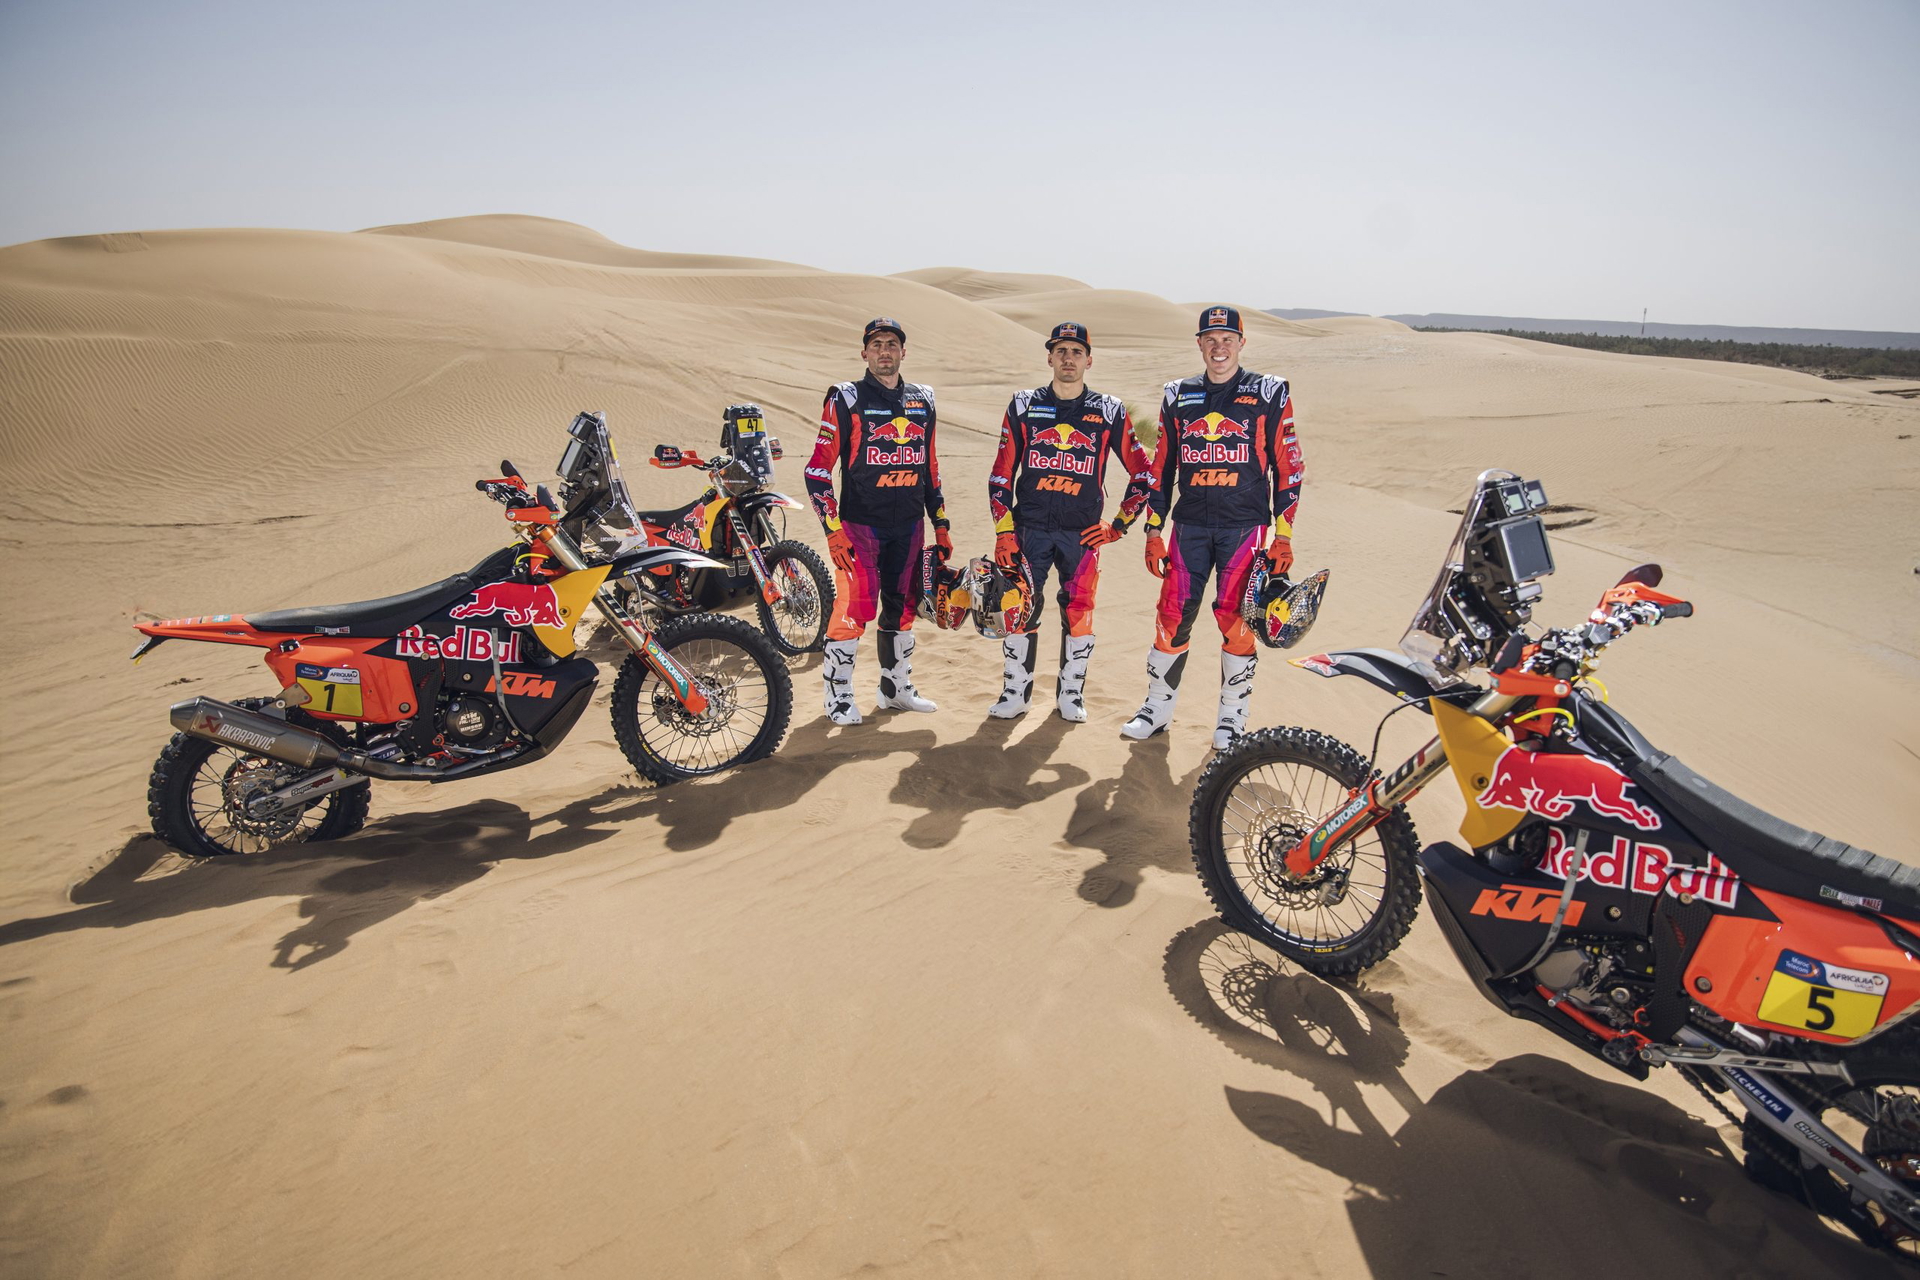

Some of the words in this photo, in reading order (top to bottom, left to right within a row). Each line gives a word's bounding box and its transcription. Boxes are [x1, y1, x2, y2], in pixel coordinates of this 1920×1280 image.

[1233, 396, 1259, 405] KTM
[747, 418, 758, 431] 47
[1082, 414, 1104, 424] KTM
[867, 447, 901, 464] Red
[1028, 450, 1062, 470] Red
[1063, 452, 1095, 476] Bull
[1181, 443, 1213, 463] Red
[1214, 443, 1249, 463] Bull
[805, 467, 832, 480] KTM
[876, 470, 919, 488] KTM
[1190, 469, 1239, 486] KTM
[1036, 475, 1083, 496] KTM
[923, 569, 933, 591] Bull
[1245, 579, 1257, 604] Bull
[938, 588, 947, 621] OAKLEY
[396, 624, 467, 660] Red
[656, 652, 687, 686] MOTOREX
[484, 671, 557, 699] KTM
[324, 684, 336, 711] 1
[218, 723, 276, 751] AKRAPOVIČ
[1325, 796, 1368, 834] MOTOREX
[1536, 825, 1630, 889] Red
[1631, 841, 1740, 909] Bull
[1470, 884, 1587, 927] KTM
[1785, 960, 1809, 973] Telecom
[1791, 956, 1810, 968] Maroc
[1830, 972, 1874, 986] AFRIQUIA
[1805, 986, 1835, 1031] 5
[1724, 1066, 1783, 1112] MICHELIN
